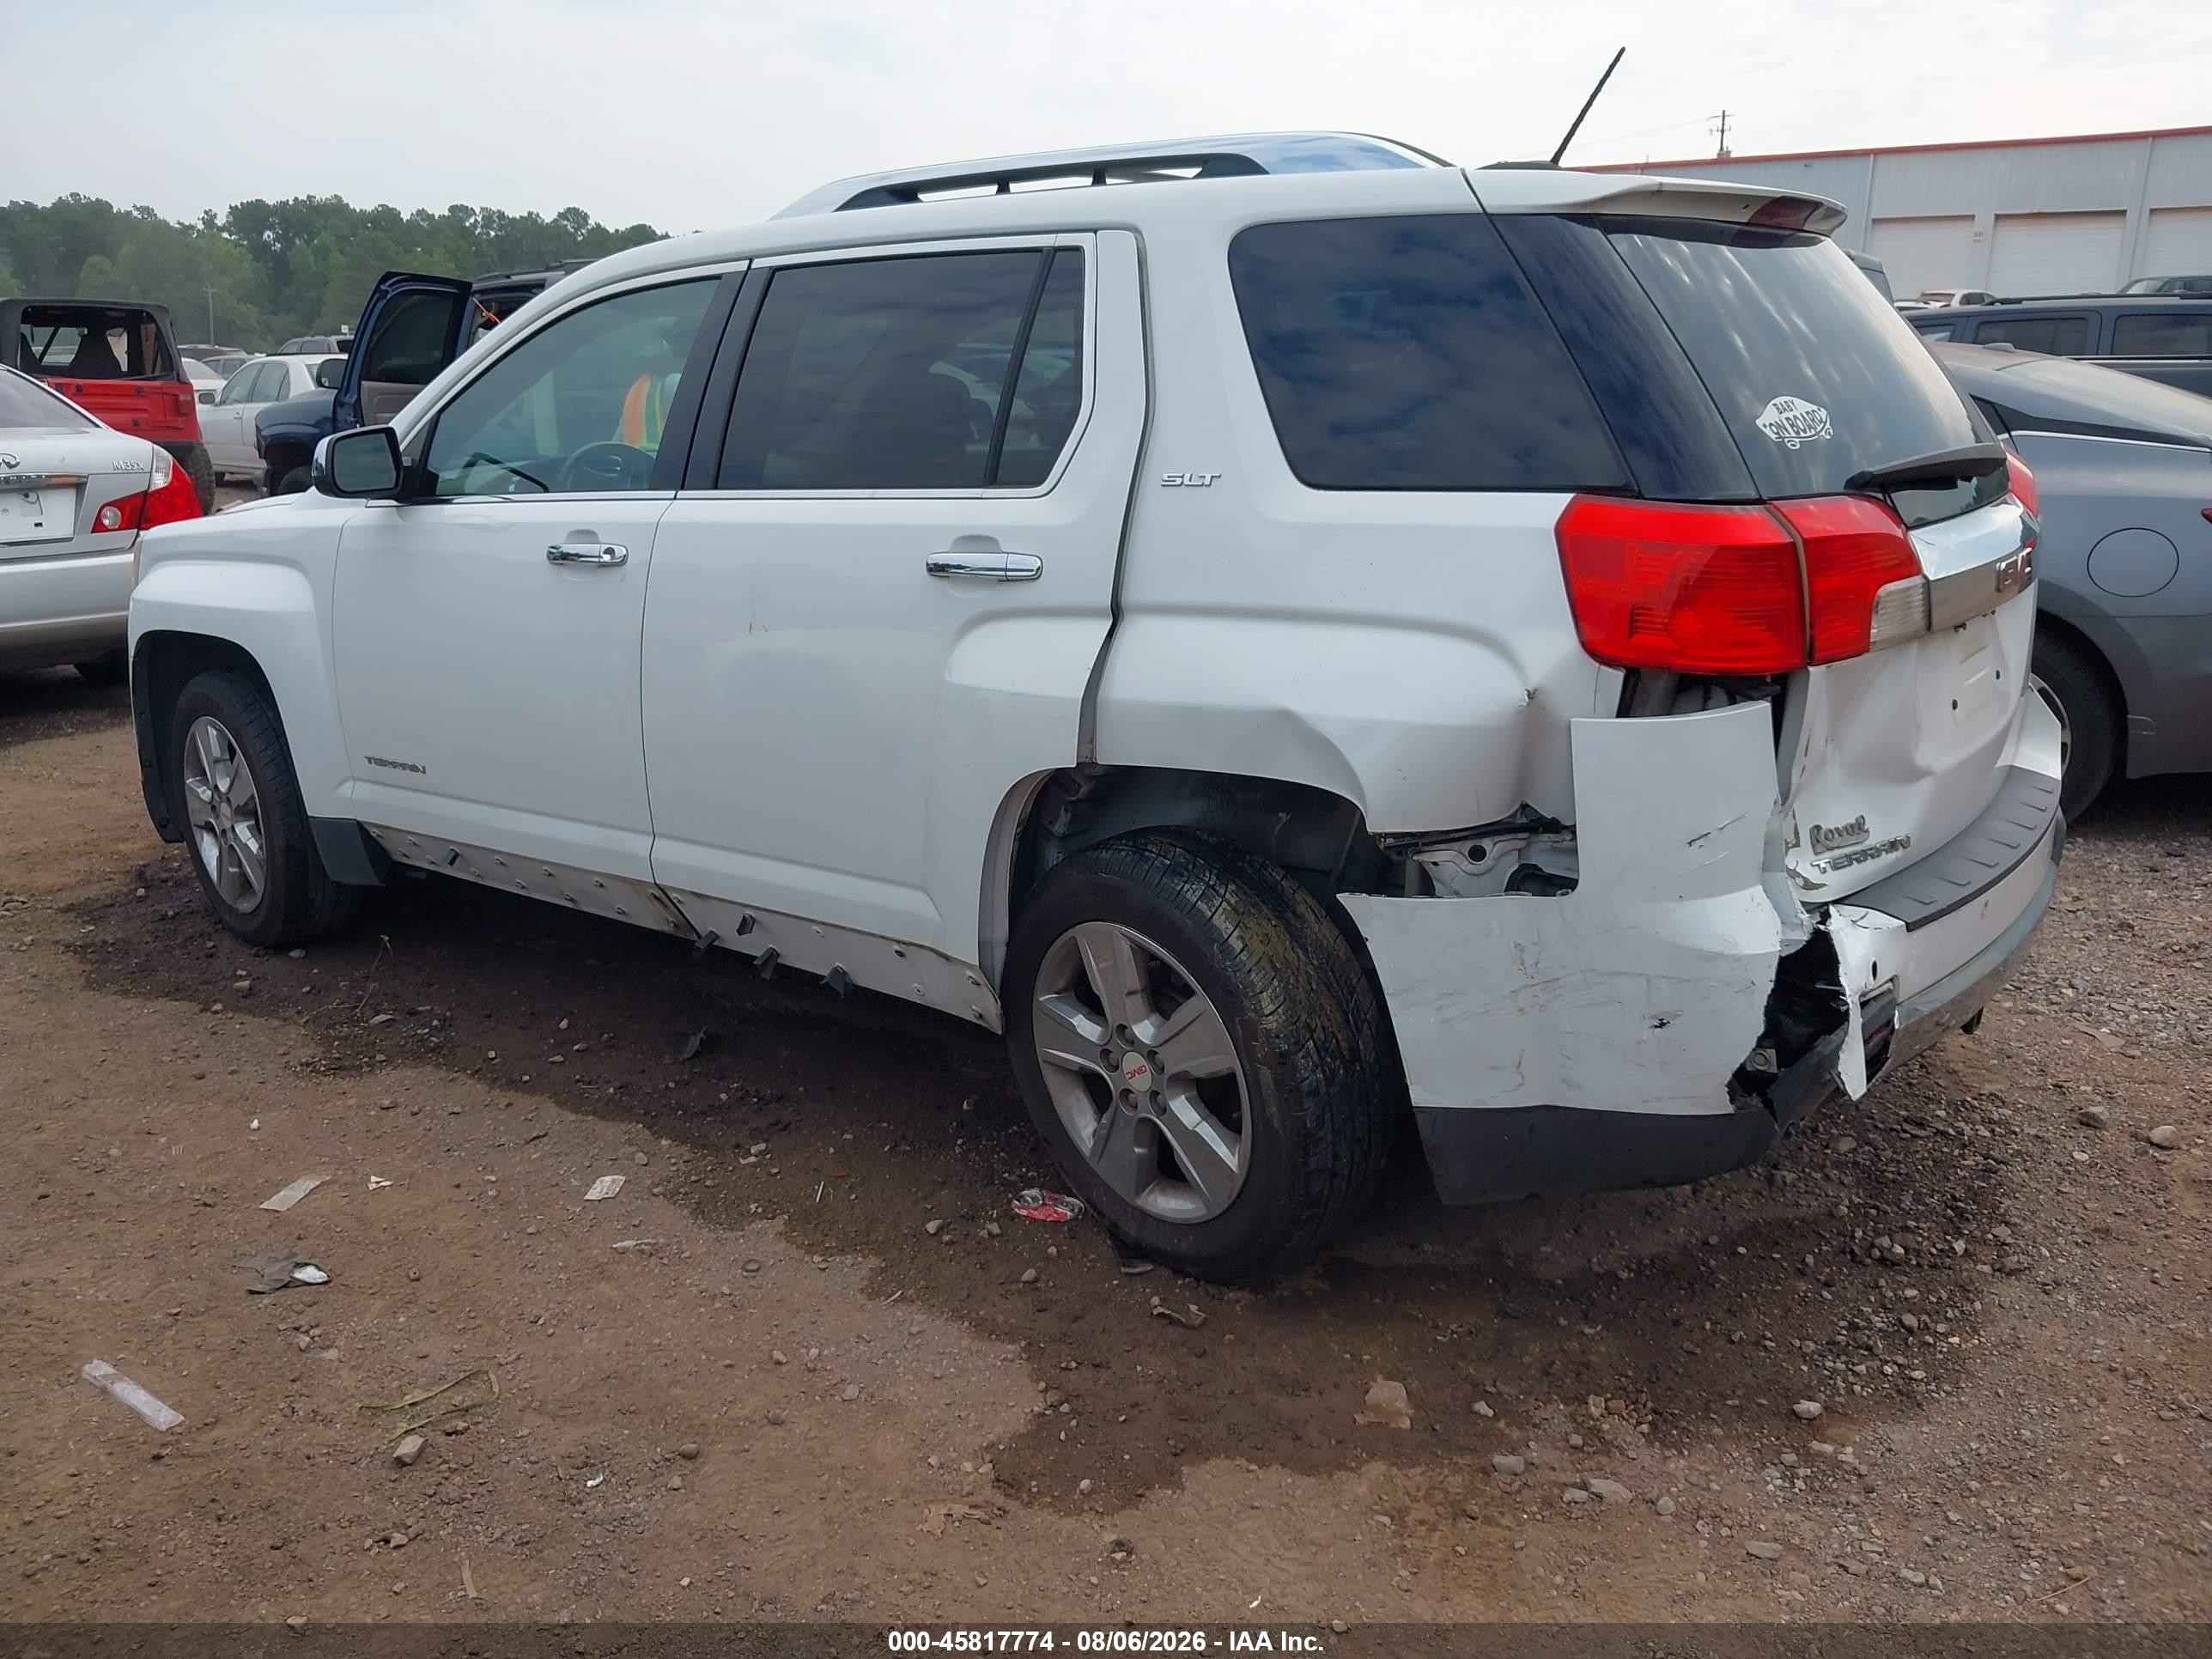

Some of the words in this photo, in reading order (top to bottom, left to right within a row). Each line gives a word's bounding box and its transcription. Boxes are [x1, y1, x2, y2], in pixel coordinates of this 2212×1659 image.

[1772, 398, 1799, 415] BABY
[1160, 471, 1222, 487] SLT
[363, 755, 427, 775] TERRAIN
[1810, 833, 1911, 875] TERRAIN
[1125, 1064, 1148, 1080] GMC
